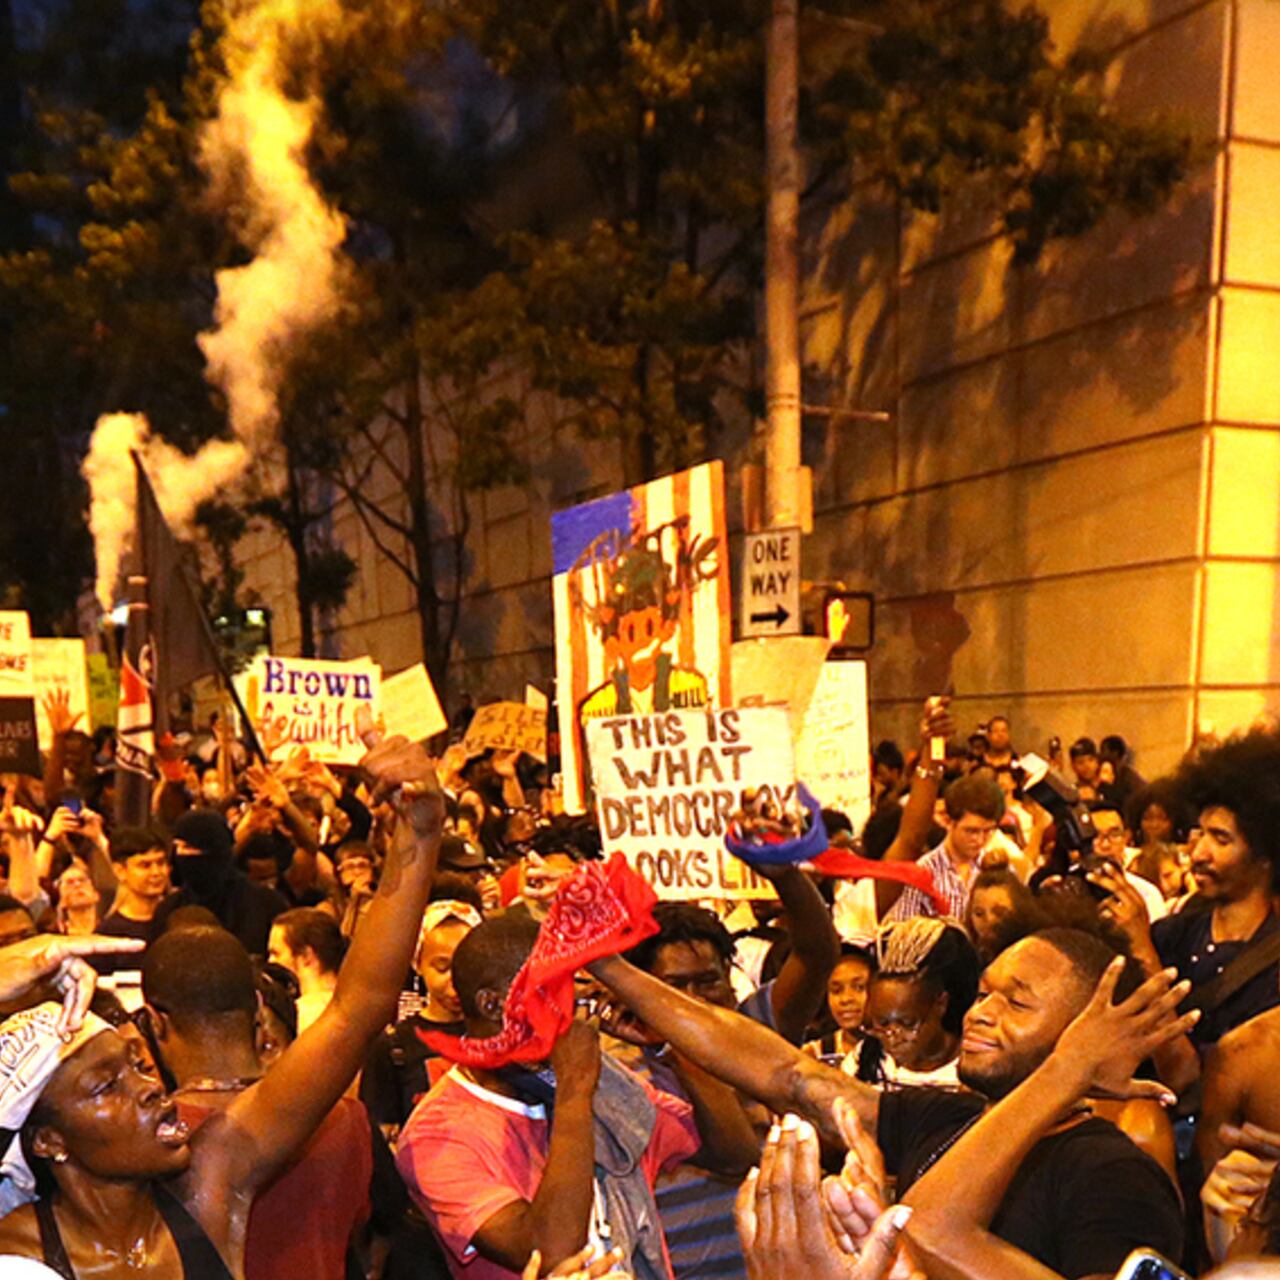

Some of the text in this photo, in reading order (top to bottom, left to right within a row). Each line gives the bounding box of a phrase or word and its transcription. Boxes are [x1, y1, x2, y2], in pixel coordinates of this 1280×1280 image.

[752, 538, 791, 564] ONE
[750, 569, 792, 597] WAY
[262, 659, 373, 699] Brown
[601, 709, 741, 750] THIS IS
[611, 745, 753, 790] WHAT
